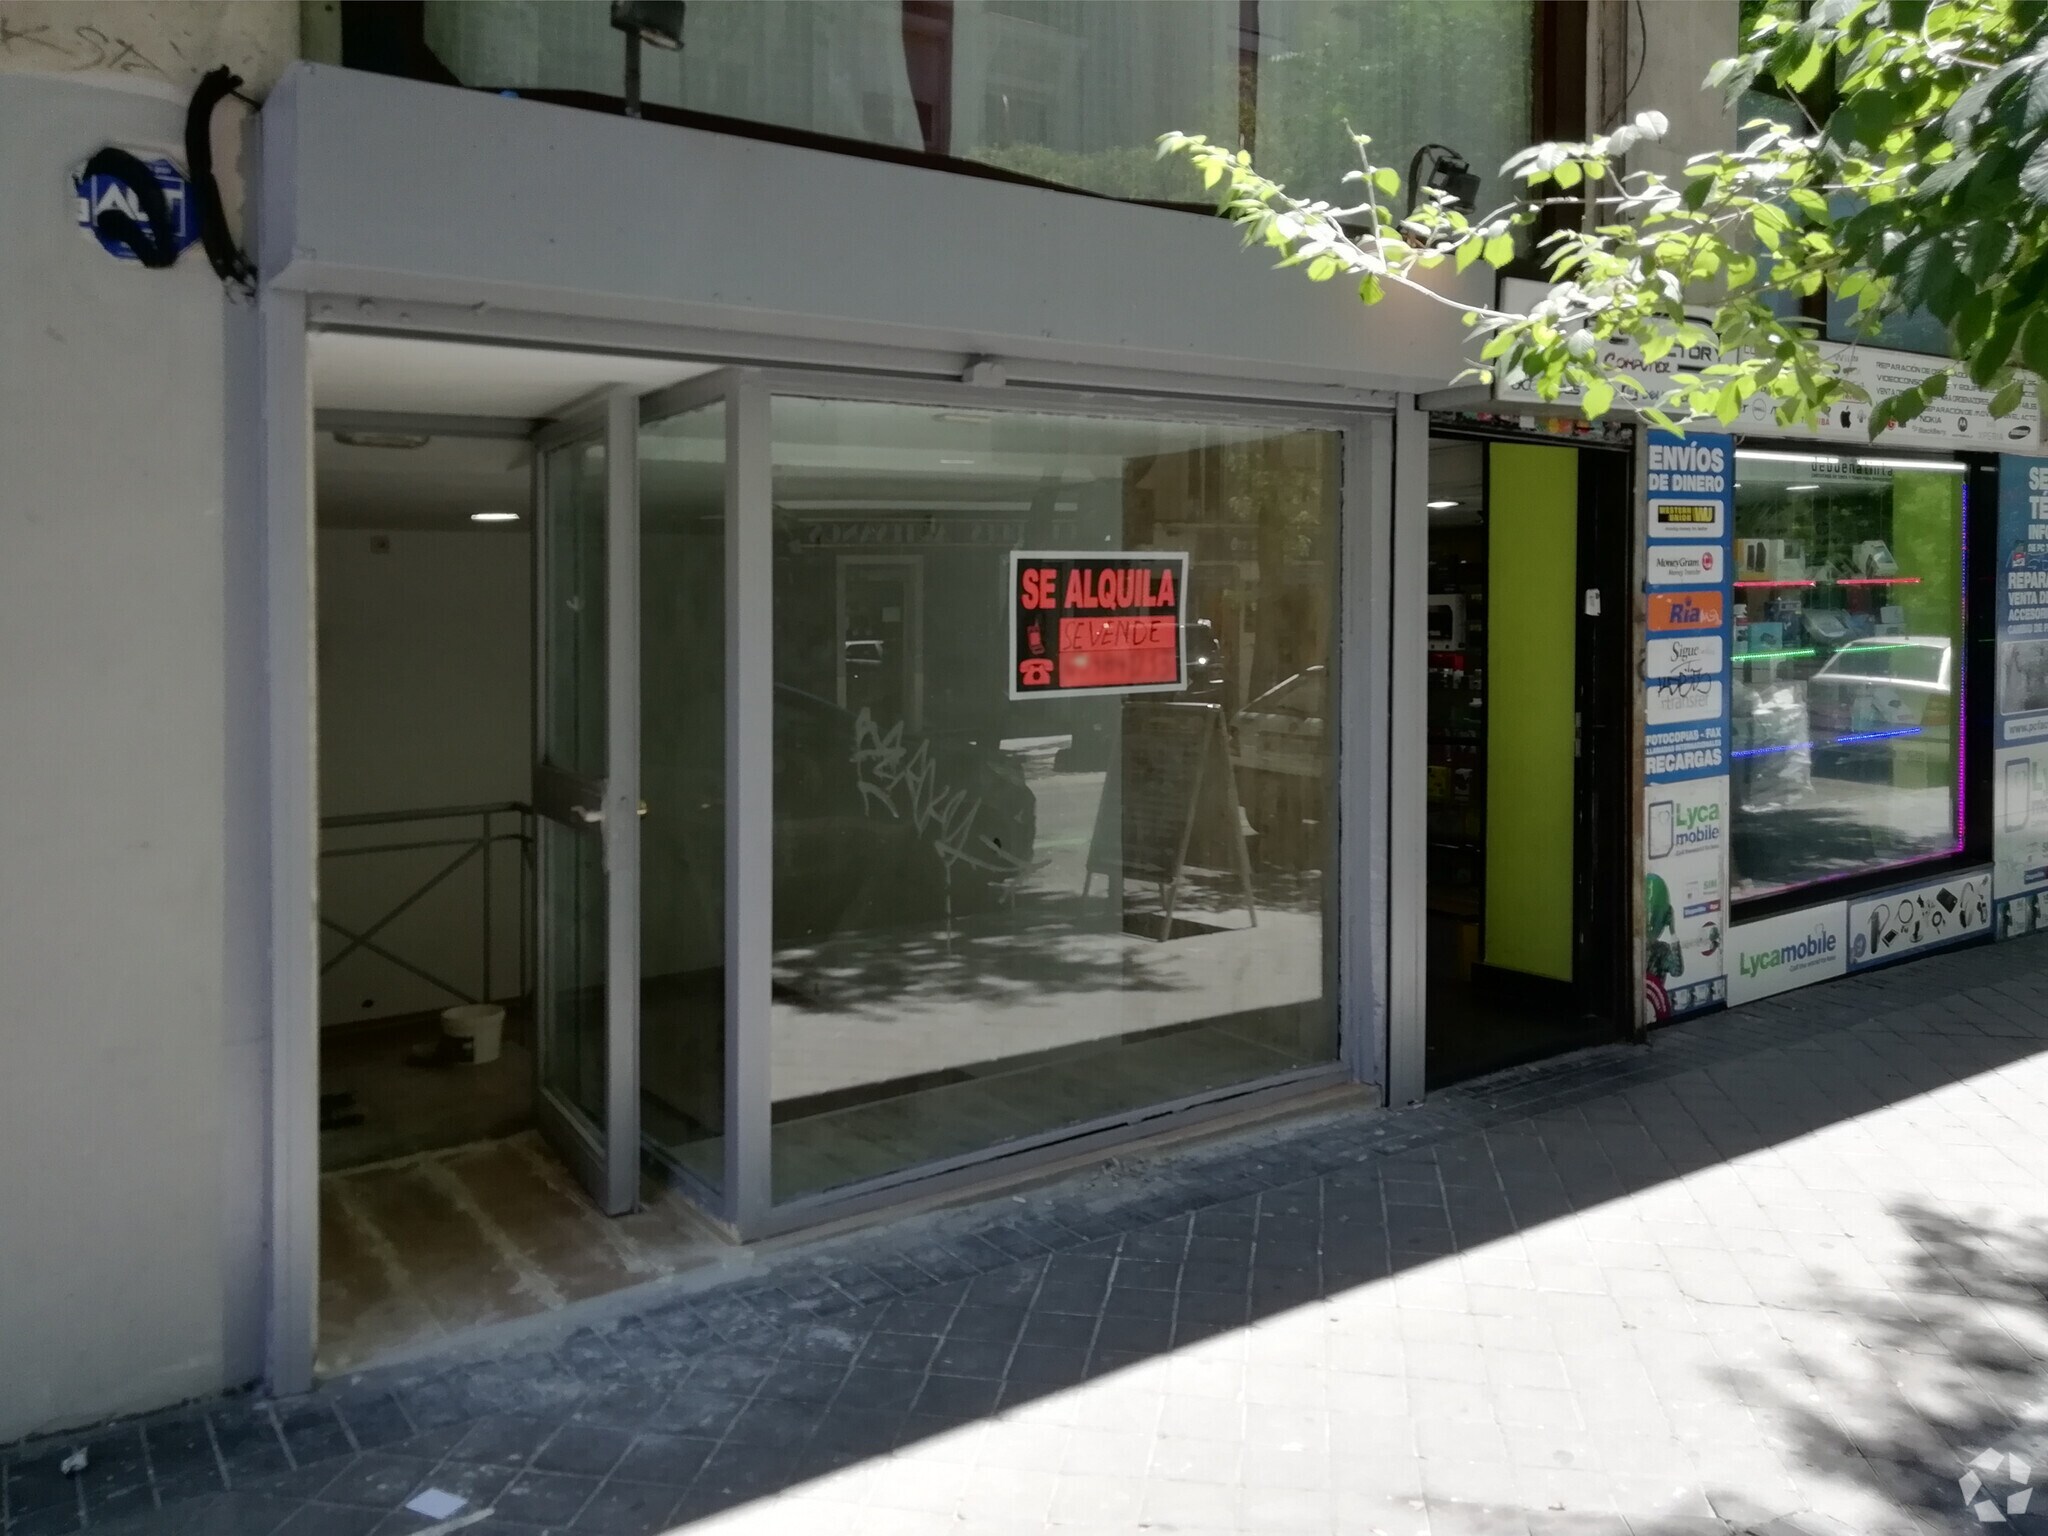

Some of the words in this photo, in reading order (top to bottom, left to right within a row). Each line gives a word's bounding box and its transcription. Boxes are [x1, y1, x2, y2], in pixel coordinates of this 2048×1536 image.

[1648, 440, 1725, 473] ENVÍOS
[1648, 472, 1669, 491] DE
[1672, 473, 1725, 492] DINERO
[1656, 557, 1700, 570] MoneyGram
[1021, 567, 1057, 610] SE
[1064, 567, 1176, 610] ALQUILA
[2008, 591, 2038, 606] VENTA
[1670, 597, 1701, 623] Ria
[1671, 641, 1700, 662] Sigue
[1646, 729, 1699, 747] FOTOCOPIAS
[1705, 727, 1722, 739] FAX
[1646, 748, 1723, 775] RECARGAS
[1676, 802, 1720, 830] Lyca
[1675, 825, 1720, 846] mobile
[1739, 930, 1837, 979] Lycamobile
